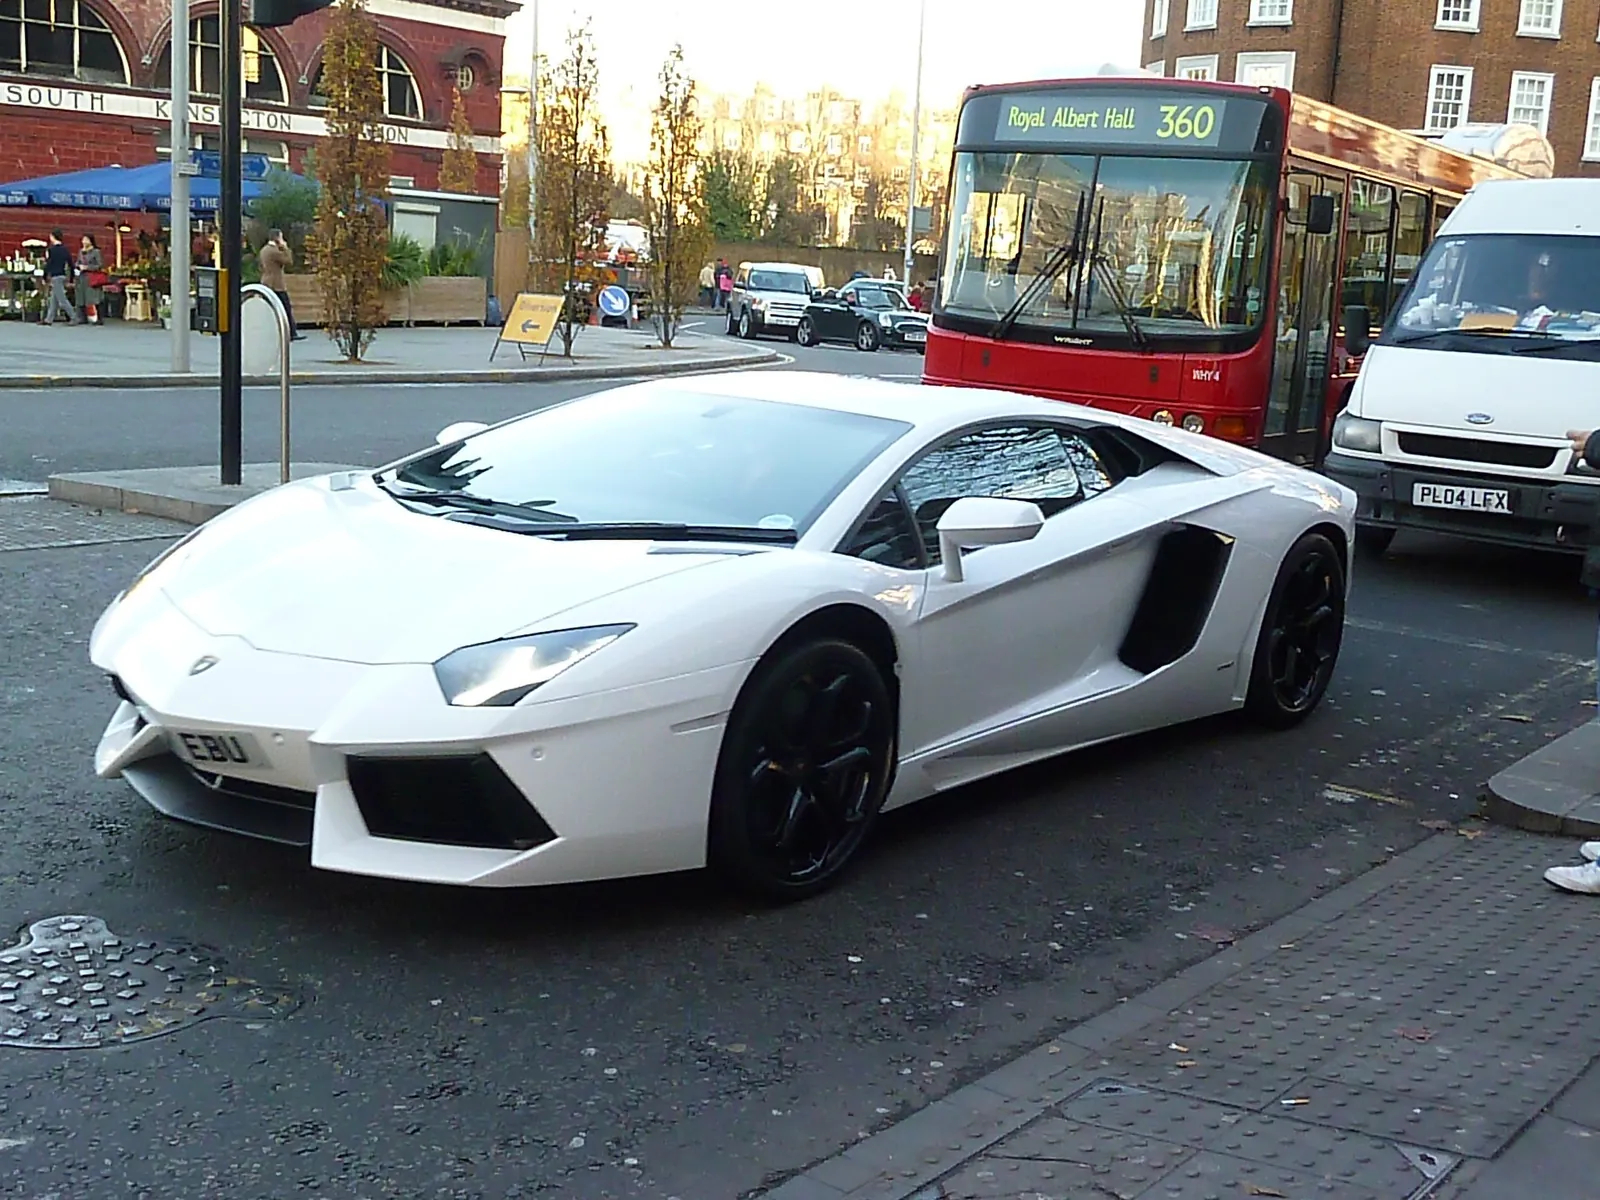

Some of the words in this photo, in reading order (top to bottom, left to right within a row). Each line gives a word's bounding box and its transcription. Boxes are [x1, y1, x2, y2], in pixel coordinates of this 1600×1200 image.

[7, 85, 104, 112] SOUTH
[155, 100, 292, 131] KNSGTON
[1007, 106, 1046, 133] Royal
[1051, 106, 1099, 129] Albert
[1103, 107, 1136, 129] Hall
[1155, 105, 1215, 139] 360
[1471, 489, 1507, 510] LFX
[177, 731, 249, 764] EBU
